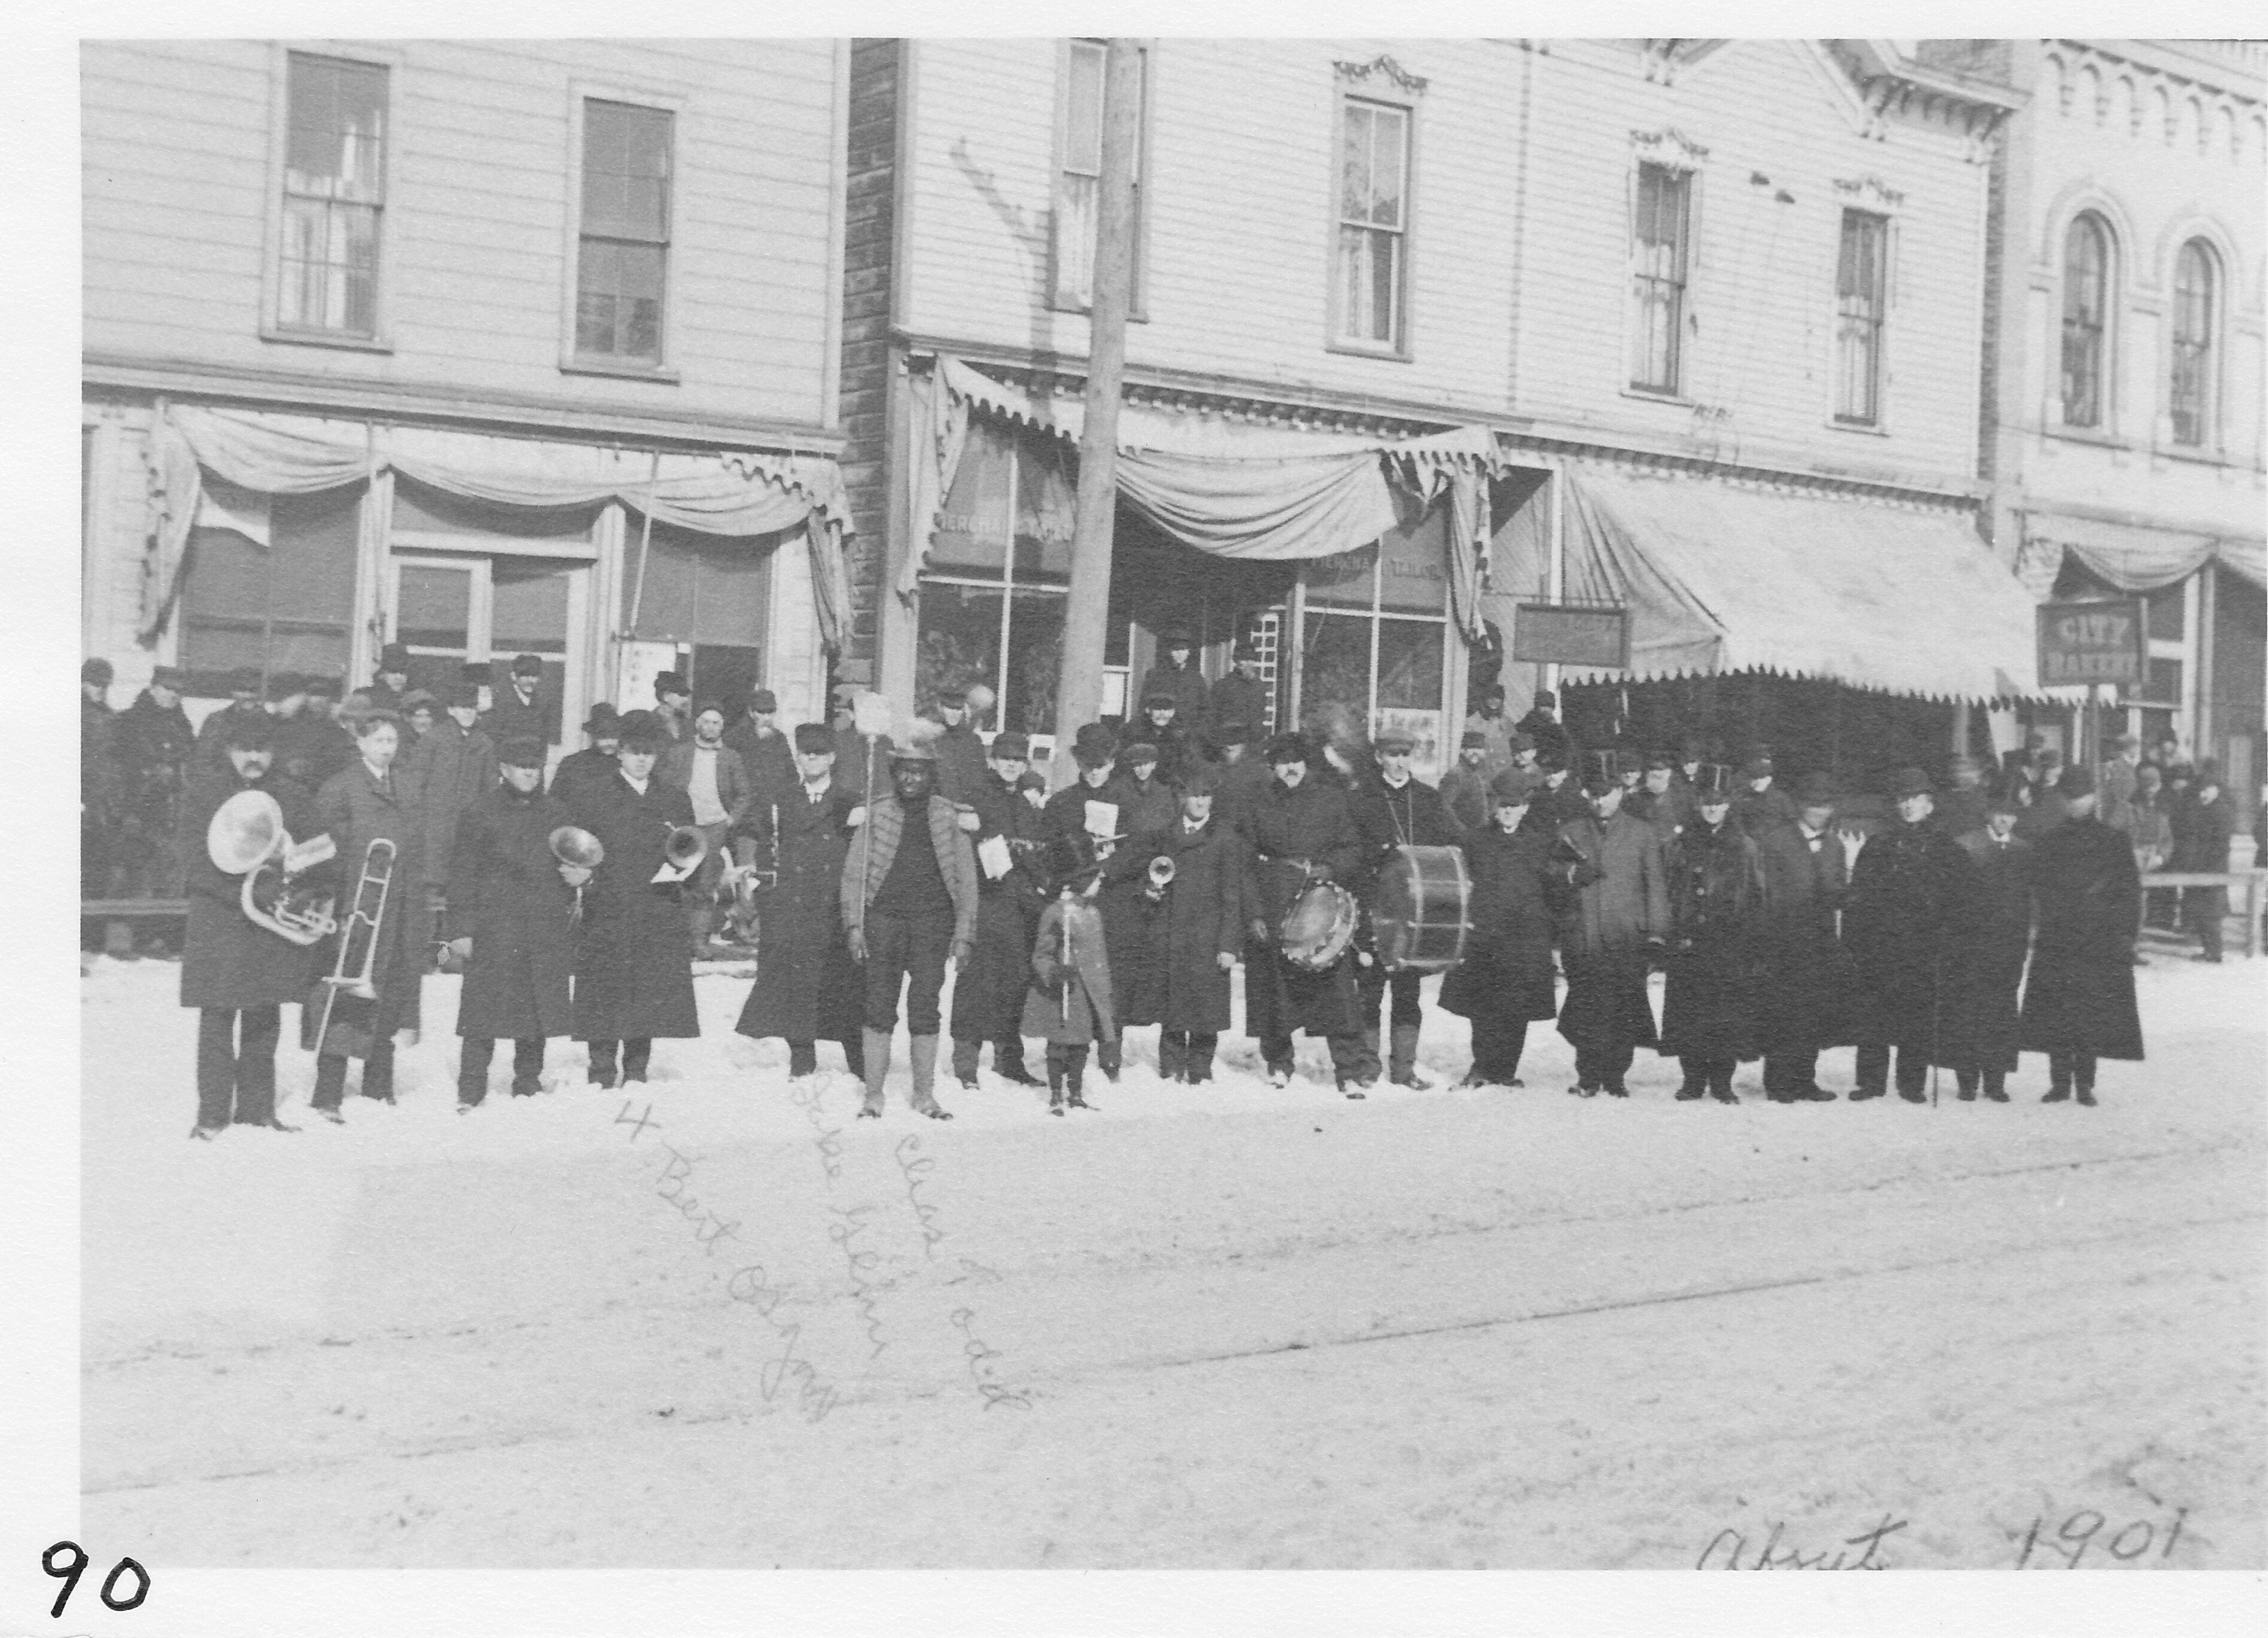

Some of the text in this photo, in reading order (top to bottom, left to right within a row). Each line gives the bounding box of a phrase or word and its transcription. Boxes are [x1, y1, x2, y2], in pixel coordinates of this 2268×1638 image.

[2057, 615, 2131, 647] CITY
[2018, 1506, 2189, 1570] 1901
[42, 1540, 151, 1618] 90
